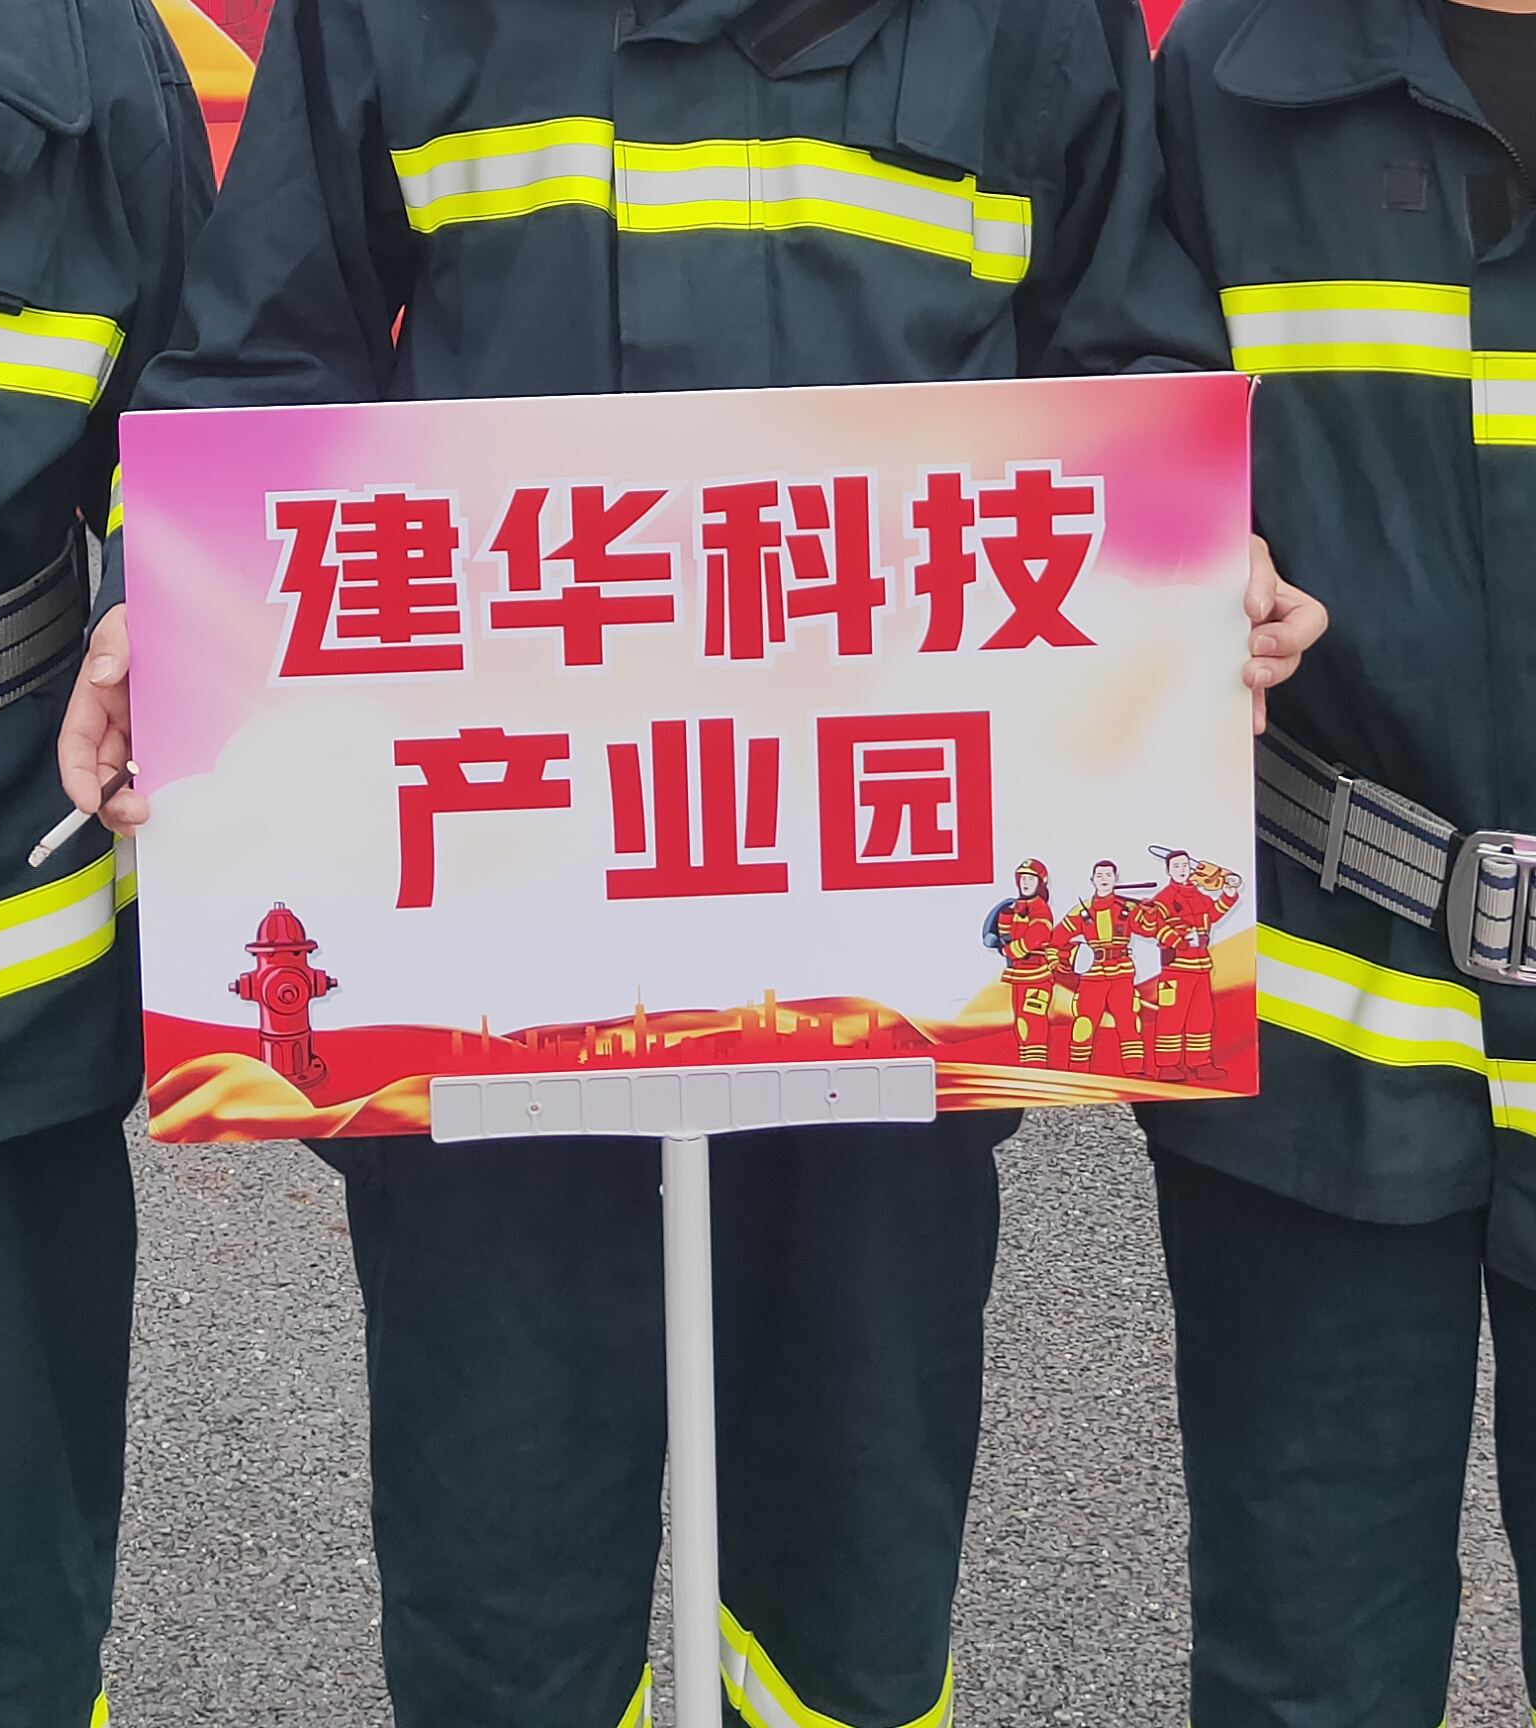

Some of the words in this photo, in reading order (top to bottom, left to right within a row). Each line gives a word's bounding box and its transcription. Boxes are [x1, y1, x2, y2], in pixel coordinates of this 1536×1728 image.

[274, 465, 1098, 678] 建华科技
[394, 710, 996, 910] 产业园
